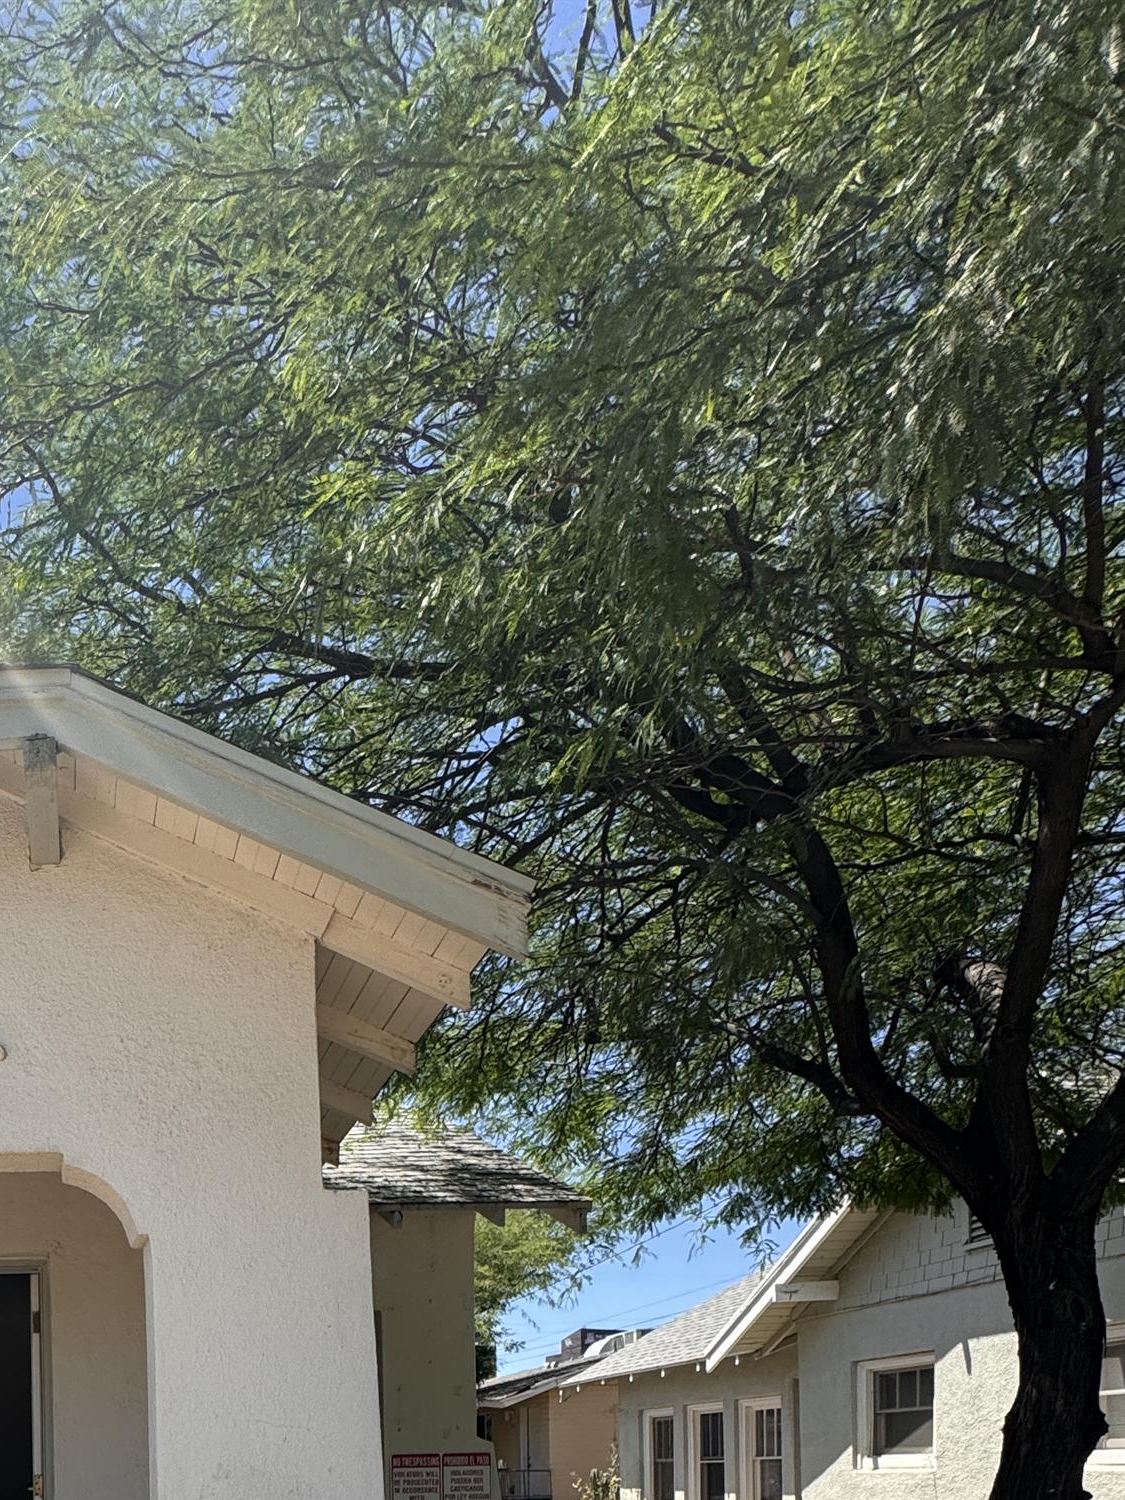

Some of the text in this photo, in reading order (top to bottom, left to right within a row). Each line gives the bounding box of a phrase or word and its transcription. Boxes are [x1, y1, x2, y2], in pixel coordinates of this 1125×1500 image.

[393, 1457, 439, 1466] NO TRESPASSING
[477, 1456, 489, 1464] PASO
